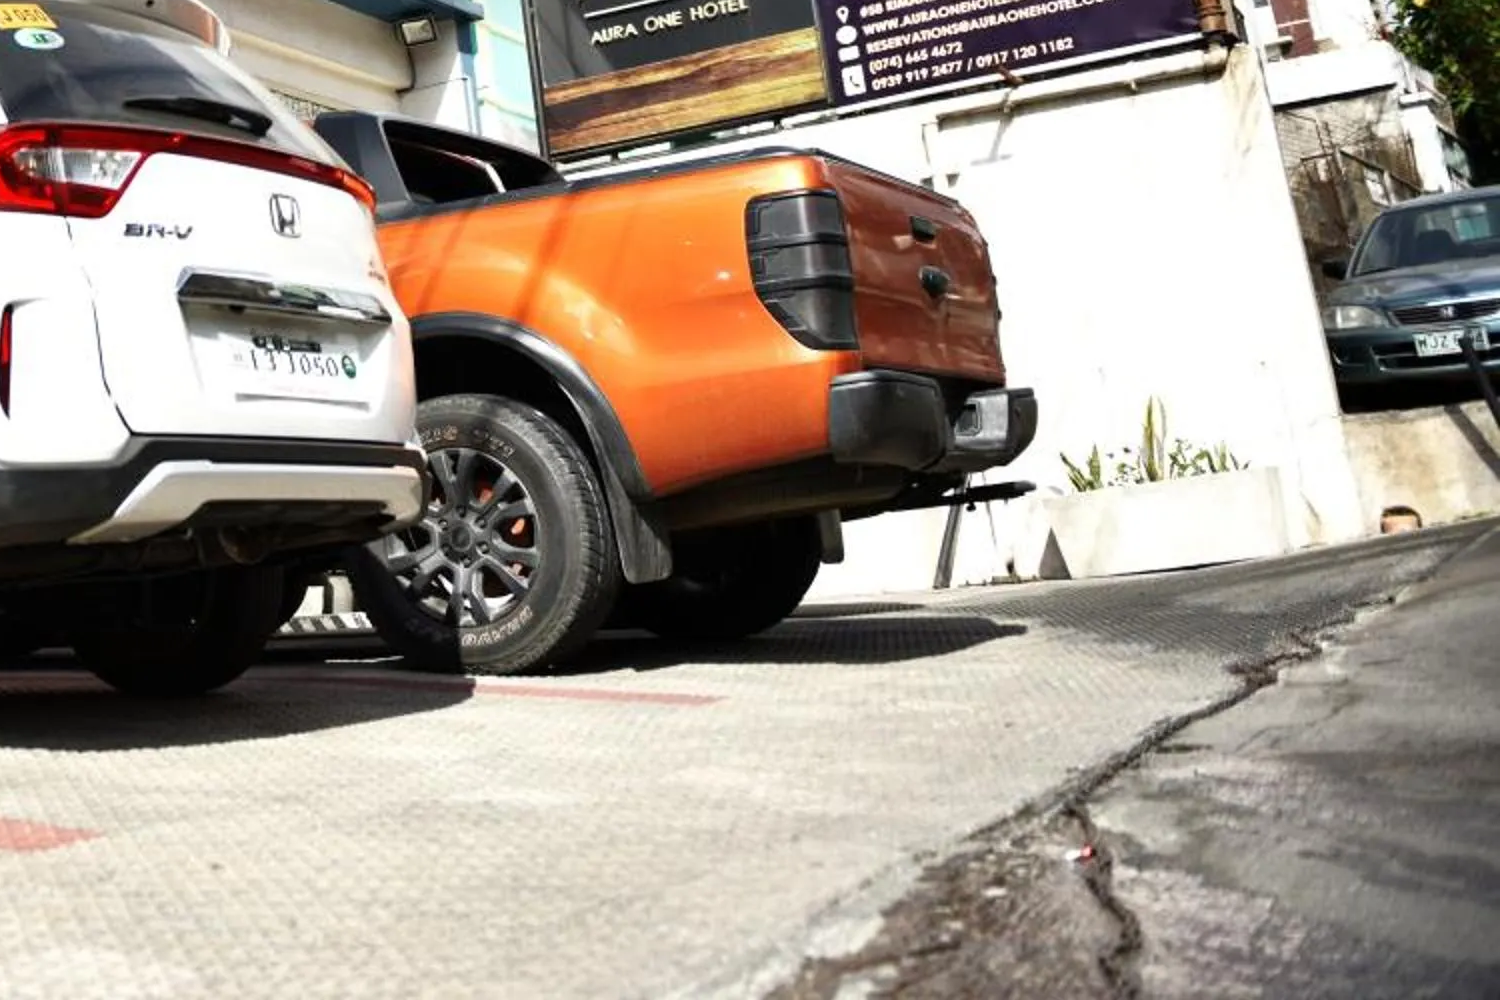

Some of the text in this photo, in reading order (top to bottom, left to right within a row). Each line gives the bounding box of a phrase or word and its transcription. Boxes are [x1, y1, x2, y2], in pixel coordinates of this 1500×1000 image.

[591, 22, 639, 46] AURA
[644, 11, 684, 33] ONE
[868, 55, 903, 75] (074)
[872, 74, 902, 91] 0939
[905, 67, 929, 83] 919
[976, 50, 1009, 68] 0917
[1012, 44, 1038, 60] 120
[1040, 36, 1074, 55] 1182
[123, 223, 193, 241] BR-V
